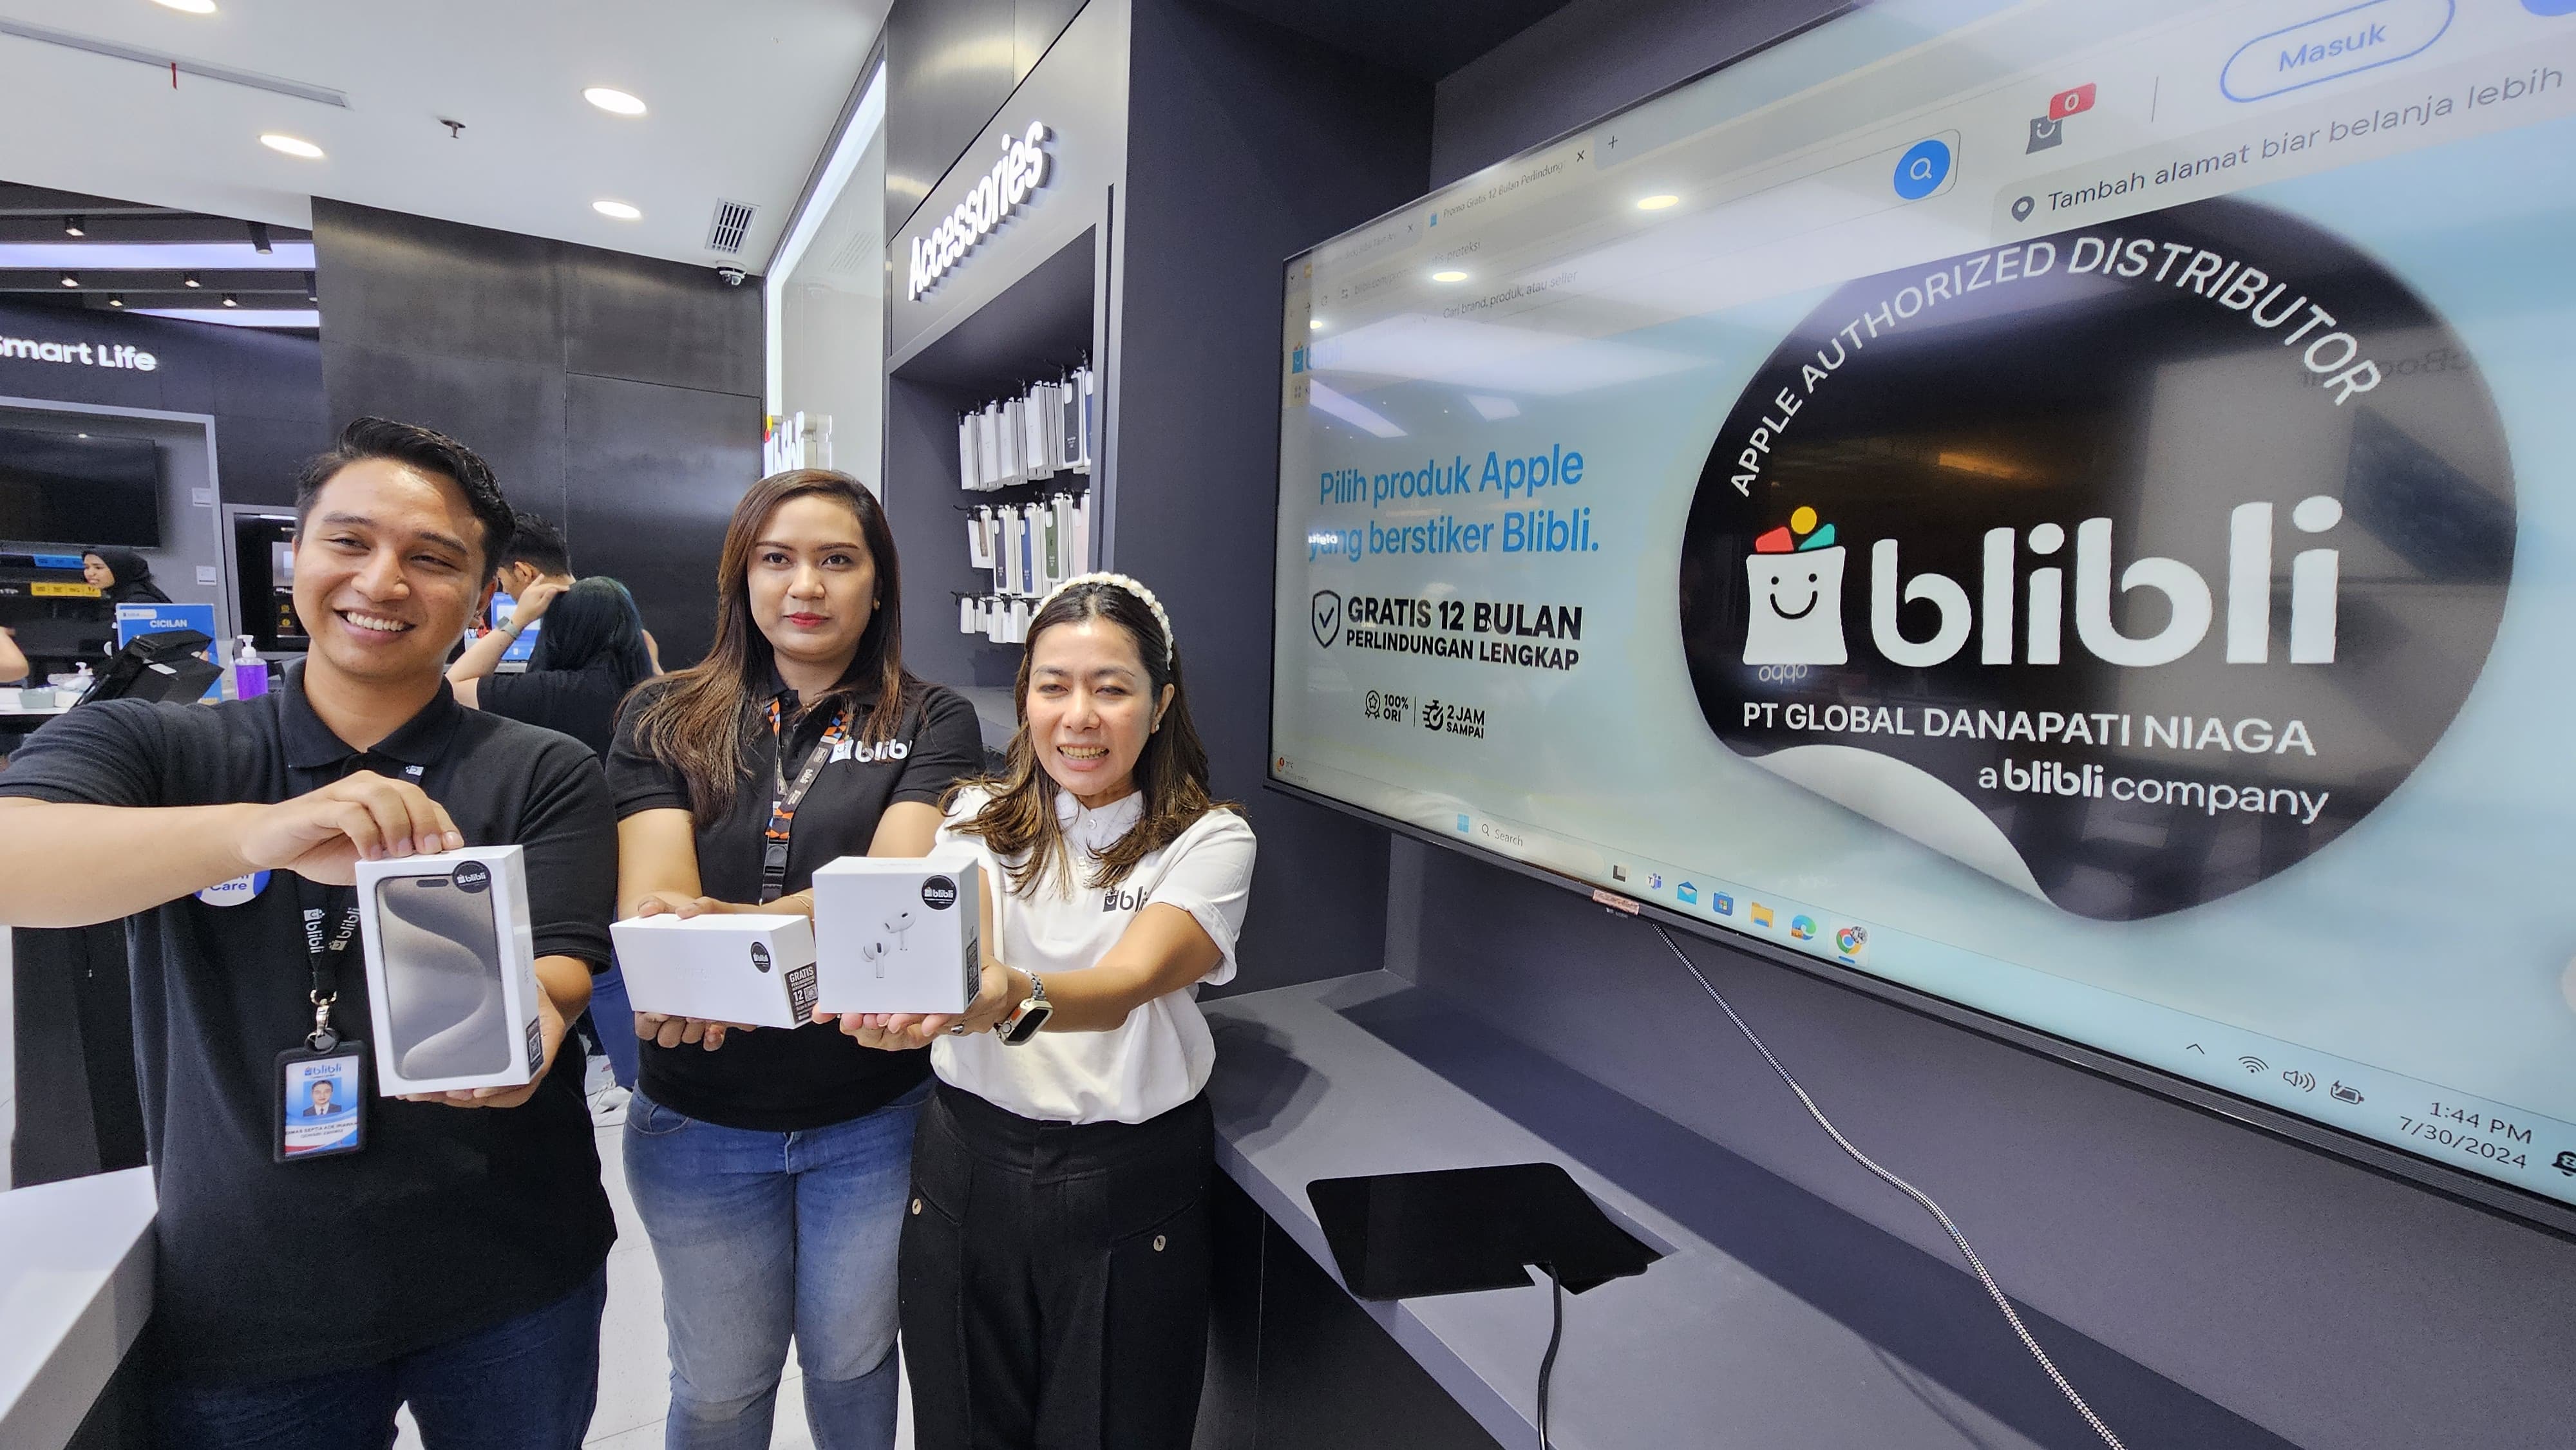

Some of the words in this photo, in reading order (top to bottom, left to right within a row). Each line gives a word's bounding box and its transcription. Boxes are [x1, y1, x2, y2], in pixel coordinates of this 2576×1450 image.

[2279, 24, 2386, 71] Masuk
[2065, 93, 2079, 111] 0
[2048, 173, 2145, 211] Tambah
[2155, 145, 2249, 185] alamat
[2262, 128, 2320, 160] biar
[2329, 95, 2452, 142] belanja
[2467, 67, 2562, 109] lebih
[1489, 188, 1497, 200] 12
[1499, 180, 1519, 195] Bulan
[908, 120, 1044, 301] Accessories
[1443, 305, 1459, 319] Cari
[1462, 299, 1488, 314] brand,
[1490, 285, 1524, 308] produk,
[1526, 281, 1546, 295] atau
[1550, 271, 1578, 288] seller
[98, 344, 156, 371] Life
[1731, 387, 1803, 497] APPLE
[1803, 242, 2056, 393] AUTHORIZED
[2069, 237, 2382, 406] DISTRIBUTOR
[1320, 469, 1367, 505] Pilih
[1373, 456, 1472, 508] produk
[1479, 443, 1584, 499] Apple
[1309, 527, 1362, 563] yang
[1369, 515, 1494, 554] berstiker
[1502, 507, 1598, 552] Blibli.
[1871, 495, 2343, 667] blibli
[150, 619, 187, 628] CICILAN
[1348, 597, 1431, 628] GRATIS
[1439, 601, 1464, 630] 12
[1473, 602, 1582, 640] BULAN
[1347, 629, 1473, 659] PERLINDUNGAN
[1480, 641, 1579, 671] LENGKAP
[1383, 709, 1401, 722] ORI
[1384, 693, 1408, 710] 100%
[1447, 706, 1455, 719] 2
[1456, 707, 1485, 725] JAM
[1446, 722, 1484, 739] SAMPAI
[1744, 702, 1778, 728] PT
[1786, 704, 1914, 735] GLOBAL
[1924, 708, 2130, 746] DANAPATI
[2145, 715, 2316, 756] NIAGA
[1978, 767, 1997, 789] a
[2004, 758, 2104, 798] blibli
[2111, 777, 2329, 824] company
[1495, 829, 1522, 846] Search
[210, 881, 247, 890] Care
[465, 872, 486, 882] blibli
[305, 921, 323, 954] blibli
[337, 907, 361, 939] blibli
[789, 966, 815, 983] GRATIS
[793, 990, 804, 1001] 12
[313, 1063, 341, 1075] blibli
[2430, 1102, 2479, 1127] 1:44
[2490, 1119, 2532, 1144] PM
[2399, 1116, 2526, 1169] 7/30/2024
